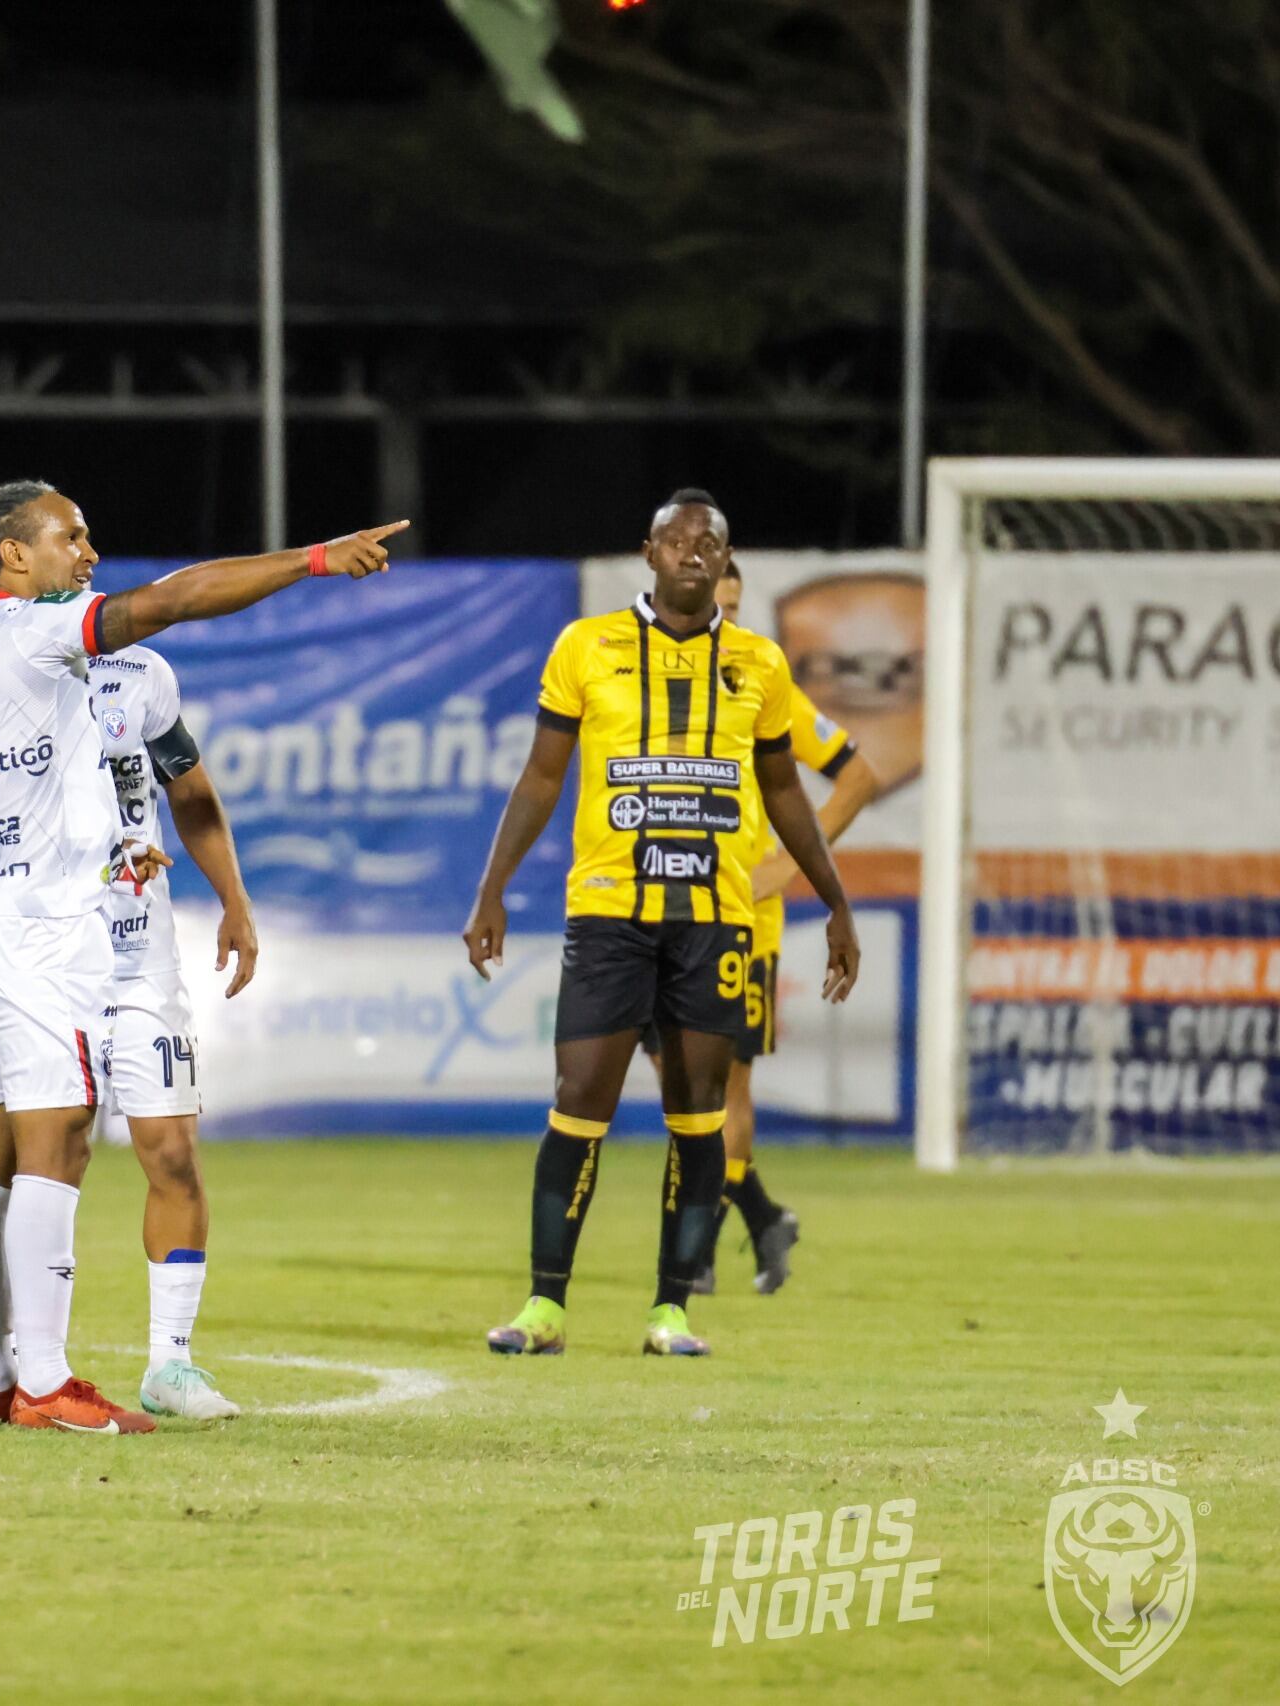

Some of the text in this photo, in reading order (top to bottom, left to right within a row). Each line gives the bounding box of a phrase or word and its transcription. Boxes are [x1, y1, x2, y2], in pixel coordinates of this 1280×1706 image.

[992, 602, 1280, 684] PARA
[97, 656, 148, 671] frutimar
[180, 696, 538, 798] ontaña
[612, 762, 735, 779] SUPER BATERIAS
[647, 797, 700, 812] Hospital
[647, 811, 668, 822] San
[669, 811, 701, 823] Rafael
[717, 950, 749, 999] 9
[152, 1035, 196, 1088] 14
